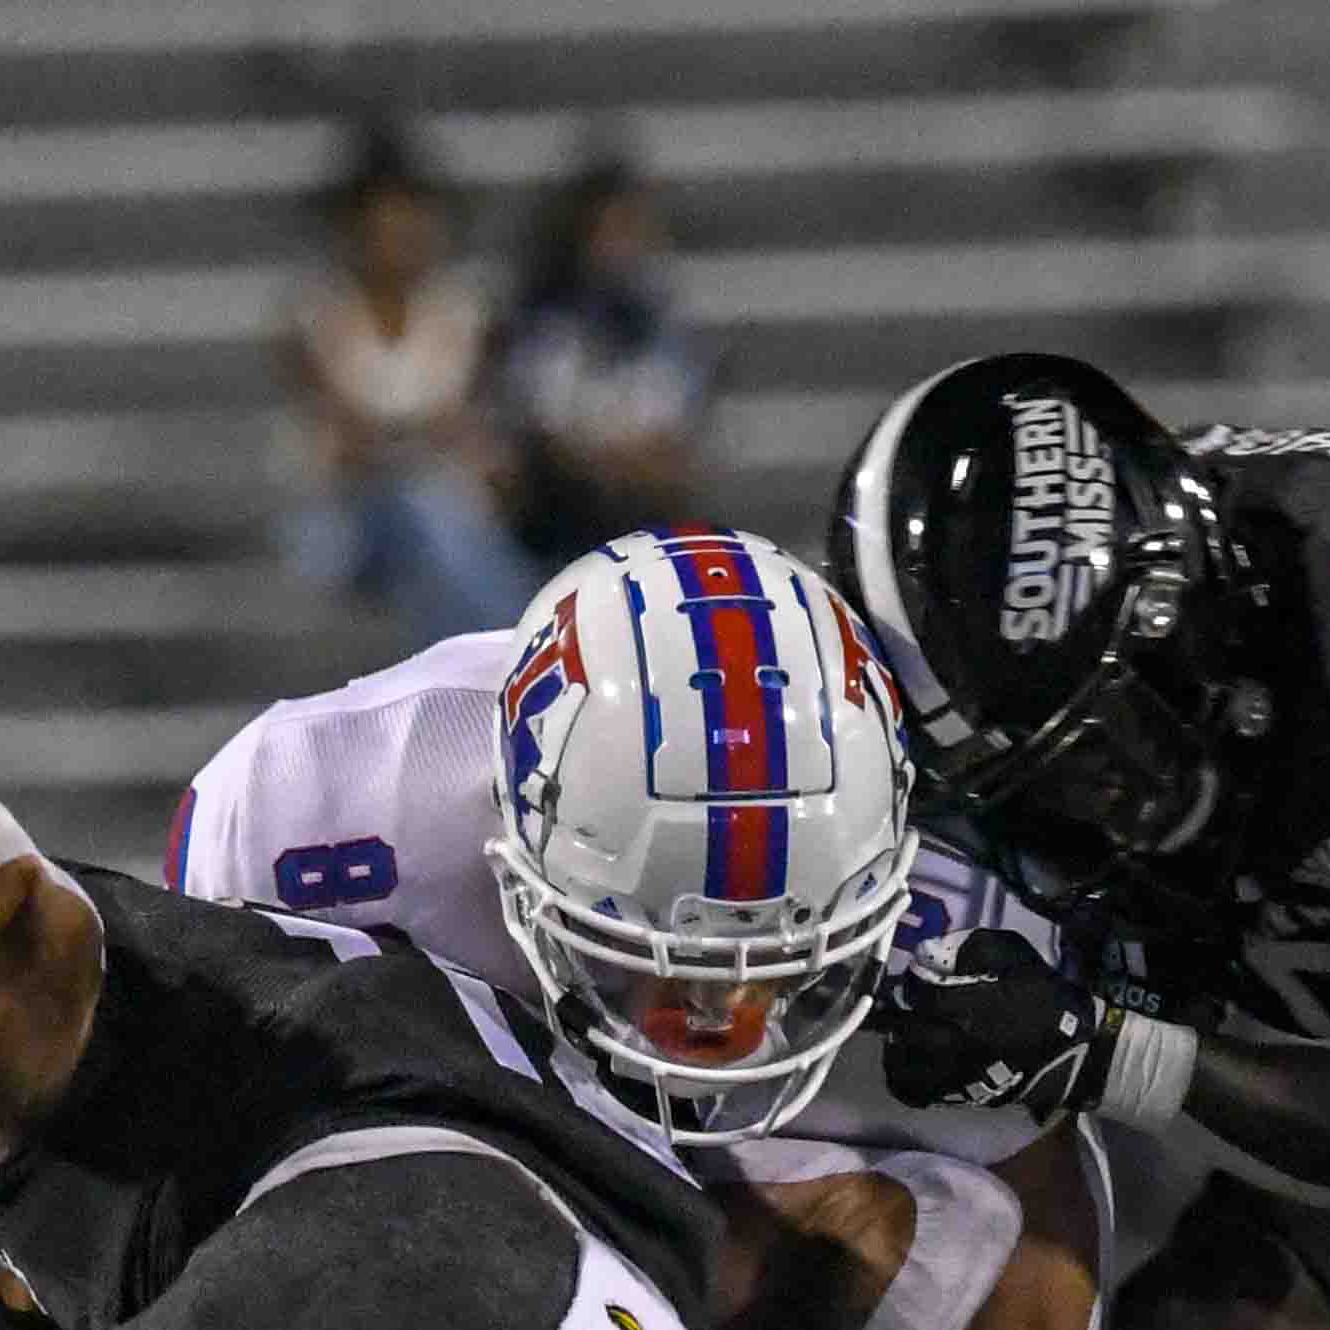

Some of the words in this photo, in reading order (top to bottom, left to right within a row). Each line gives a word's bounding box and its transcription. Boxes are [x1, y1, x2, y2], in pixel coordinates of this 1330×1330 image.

[999, 394, 1068, 640] SOUTHERN
[1065, 453, 1113, 560] MISS
[272, 833, 398, 911] 8
